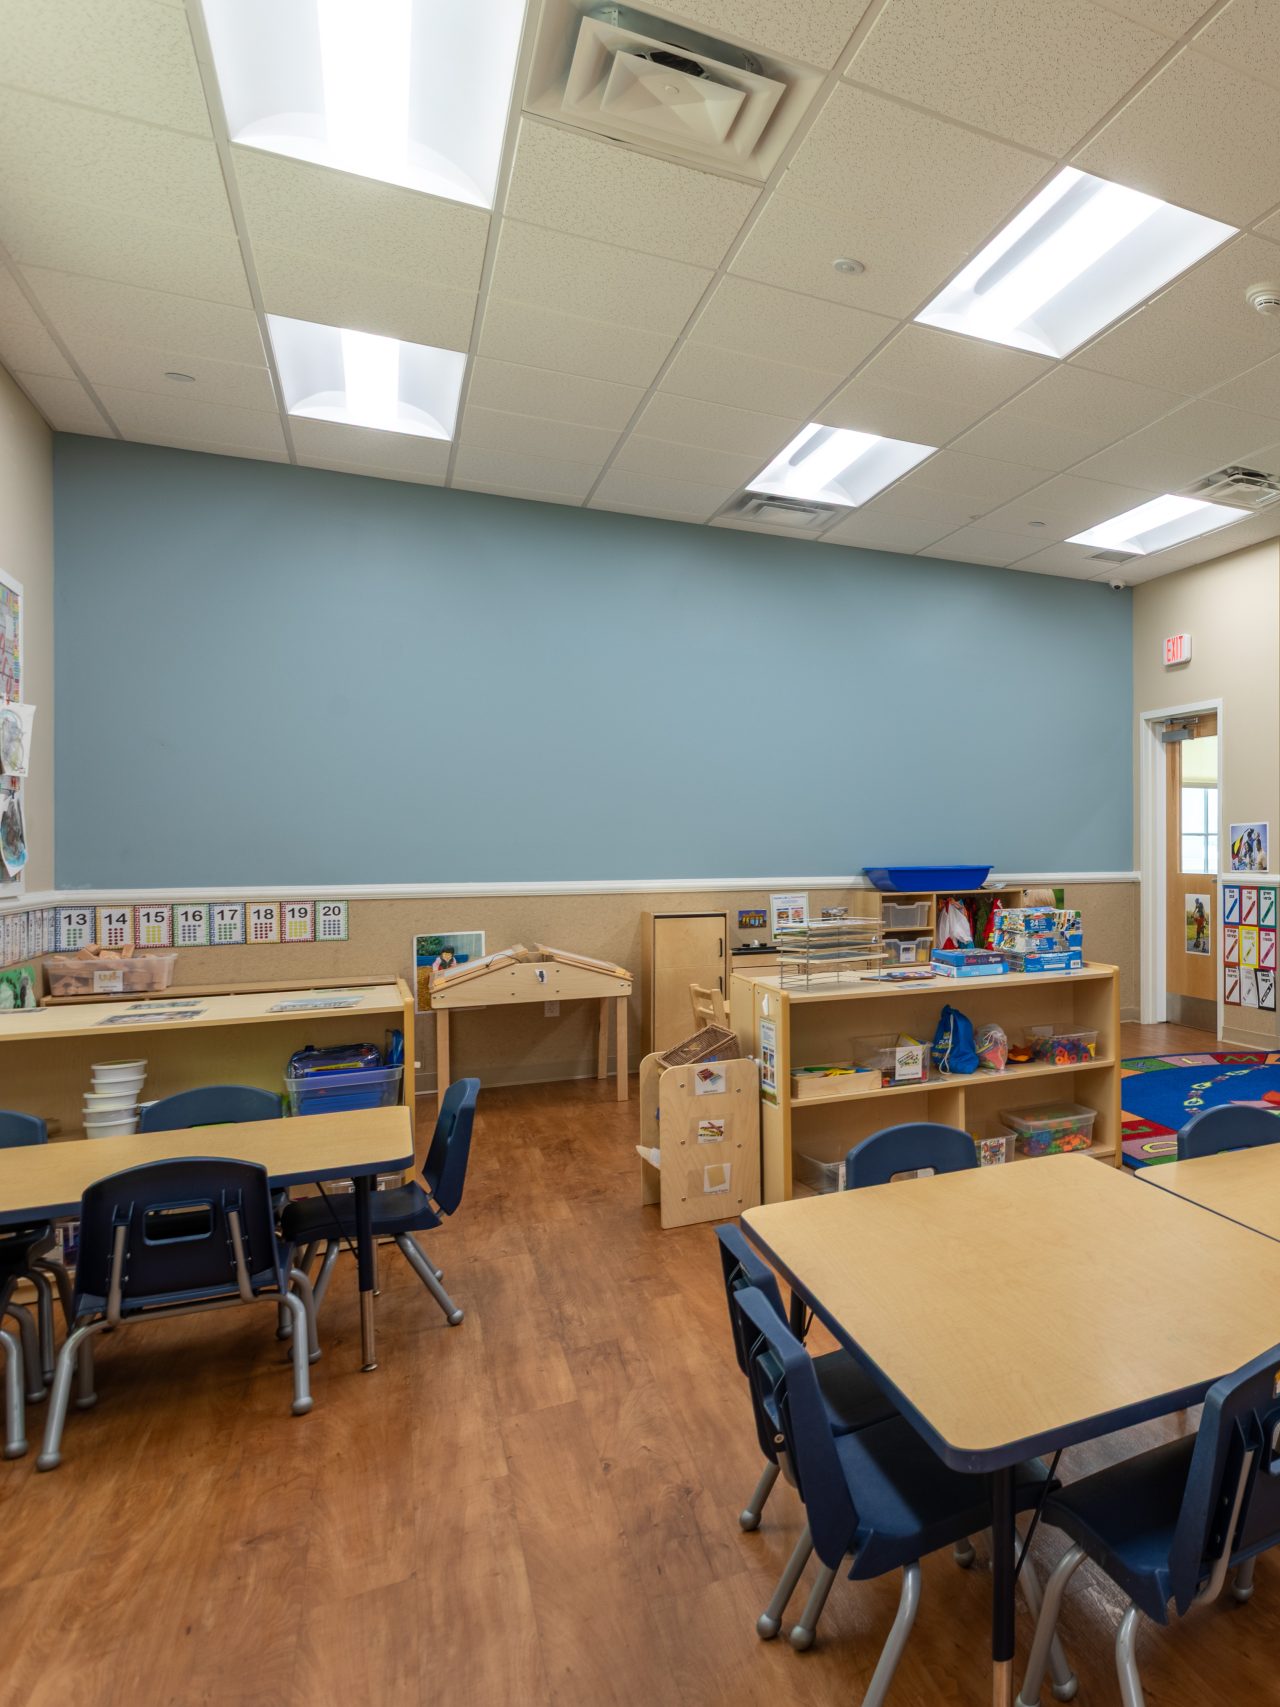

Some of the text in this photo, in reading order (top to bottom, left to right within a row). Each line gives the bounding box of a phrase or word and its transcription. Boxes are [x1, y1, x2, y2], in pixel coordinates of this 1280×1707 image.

[1166, 636, 1183, 662] EXIT
[180, 910, 203, 922] 16
[216, 909, 239, 921] 17
[253, 908, 275, 920] 18
[288, 907, 308, 919] 19
[322, 905, 342, 916] 20
[63, 913, 88, 926] 13
[103, 912, 128, 925] 14
[142, 911, 165, 923] 15
